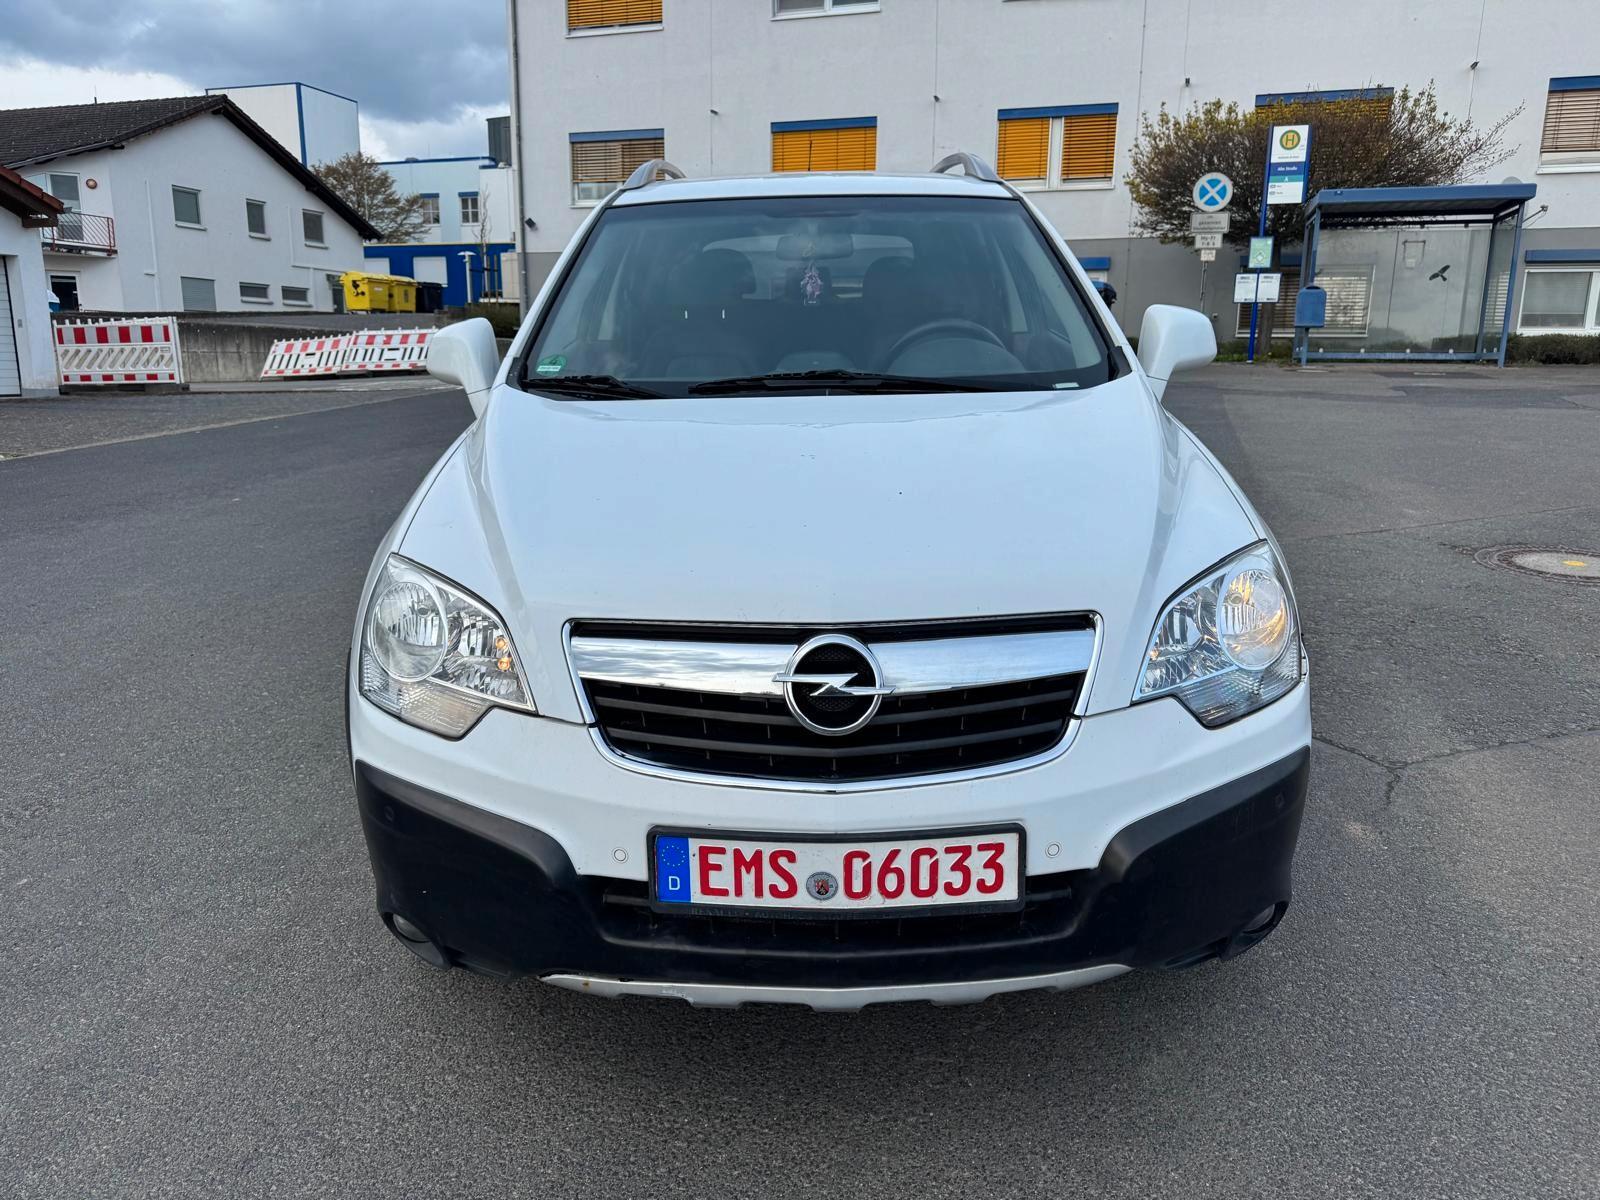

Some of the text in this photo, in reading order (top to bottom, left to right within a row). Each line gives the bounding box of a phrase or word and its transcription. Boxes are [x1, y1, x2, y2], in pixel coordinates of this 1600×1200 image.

[1285, 134, 1295, 147] H
[699, 843, 1004, 899] EMS 06033
[668, 875, 680, 890] D
